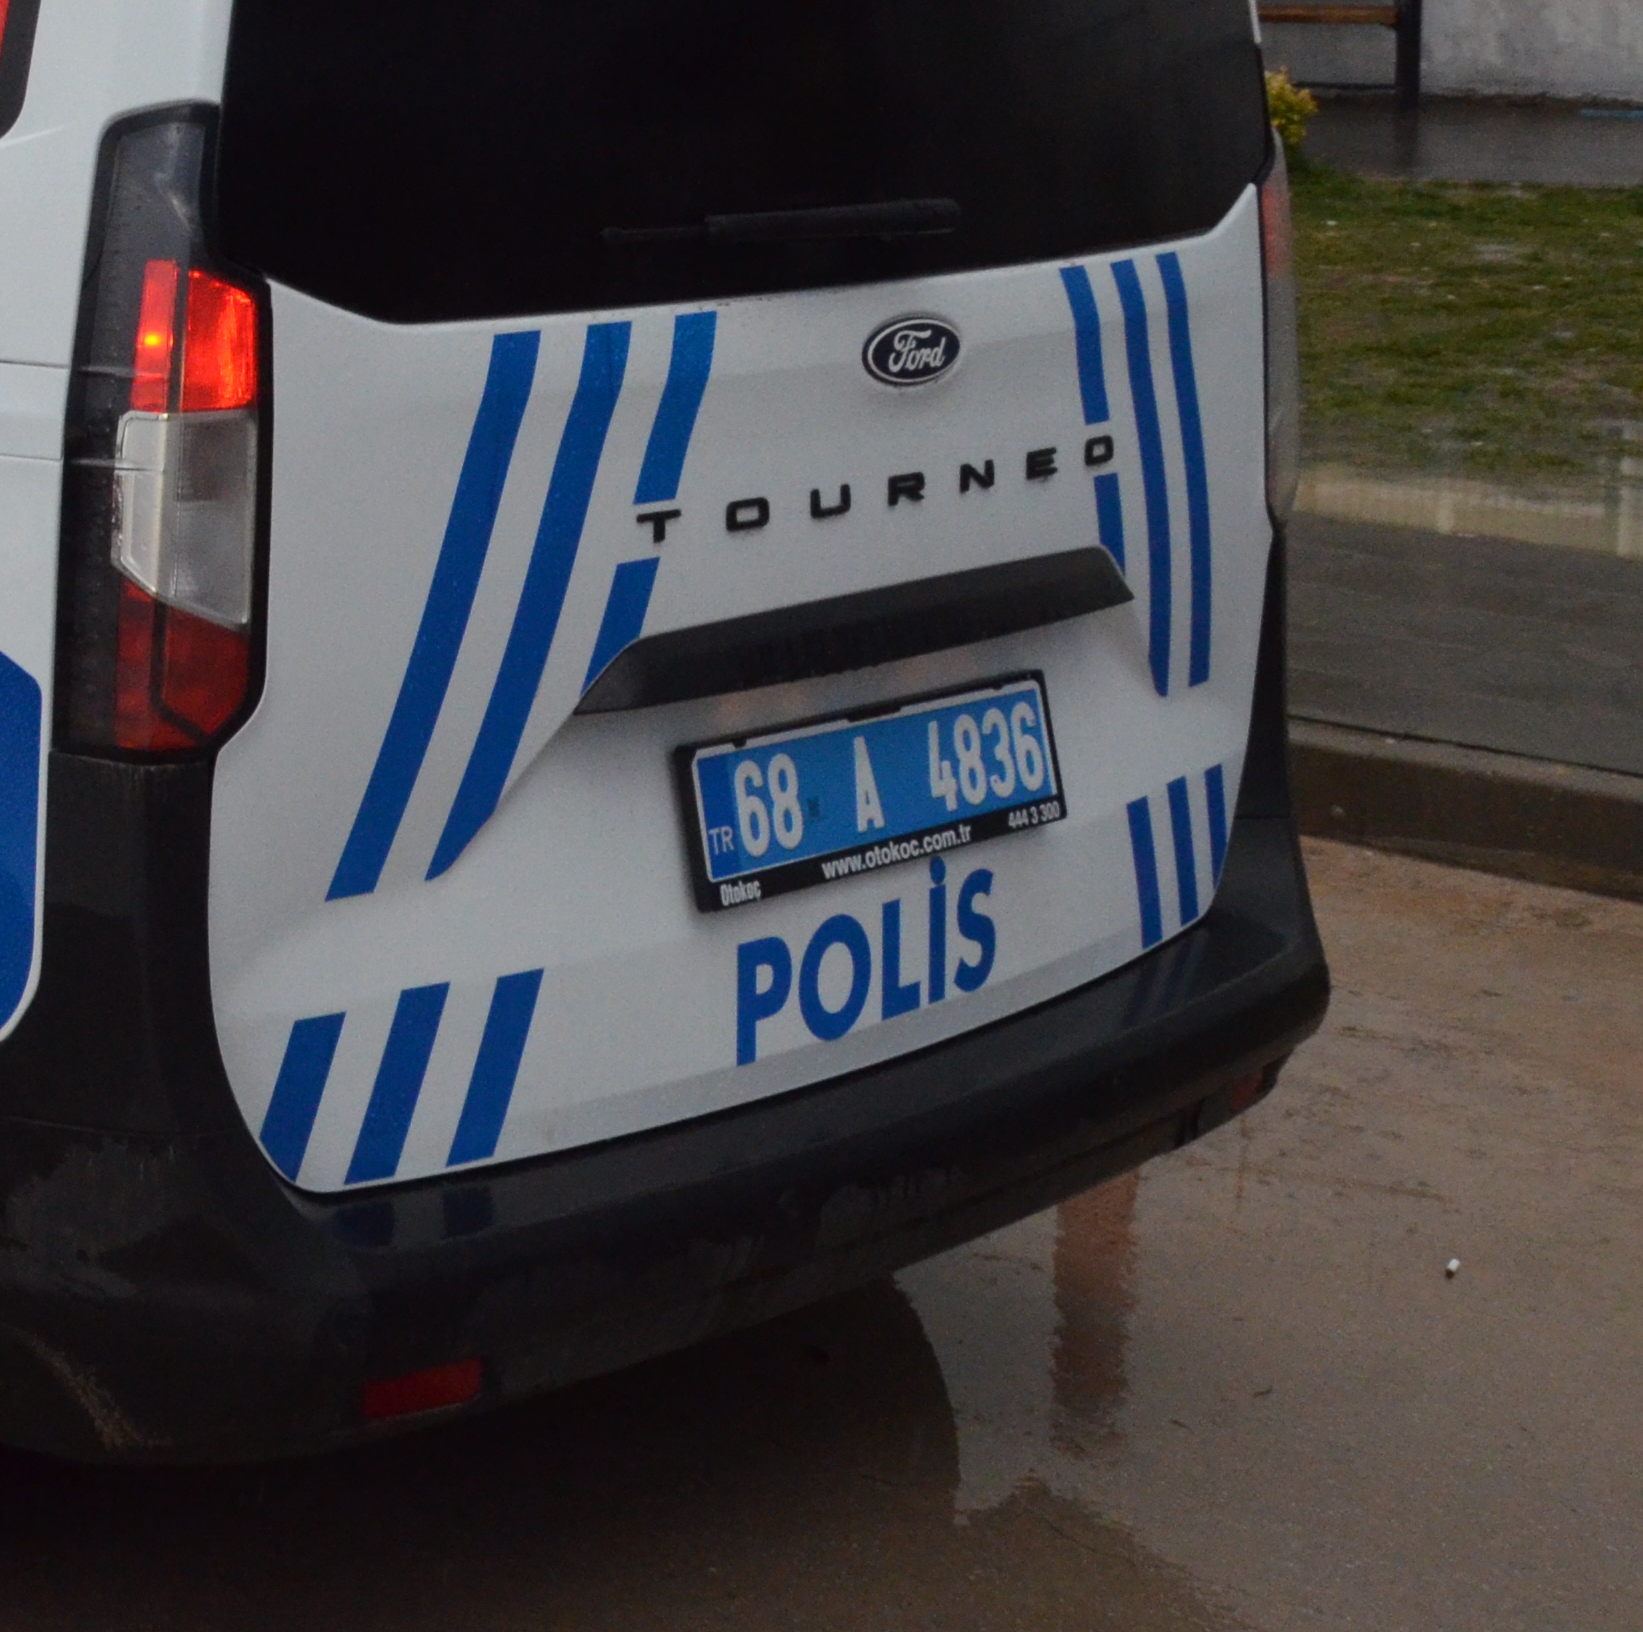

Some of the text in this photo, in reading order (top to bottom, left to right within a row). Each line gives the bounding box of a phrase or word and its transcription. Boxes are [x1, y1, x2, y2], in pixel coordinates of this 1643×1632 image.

[888, 329, 947, 374] Ford
[635, 433, 1115, 545] TOURNEO
[733, 700, 1046, 858] 68 A 4836
[708, 825, 735, 856] TR
[1007, 809, 1030, 829] 444
[1039, 800, 1061, 822] 300
[821, 823, 973, 880] www.otokoc.com.tr
[735, 854, 997, 1068] POLİS
